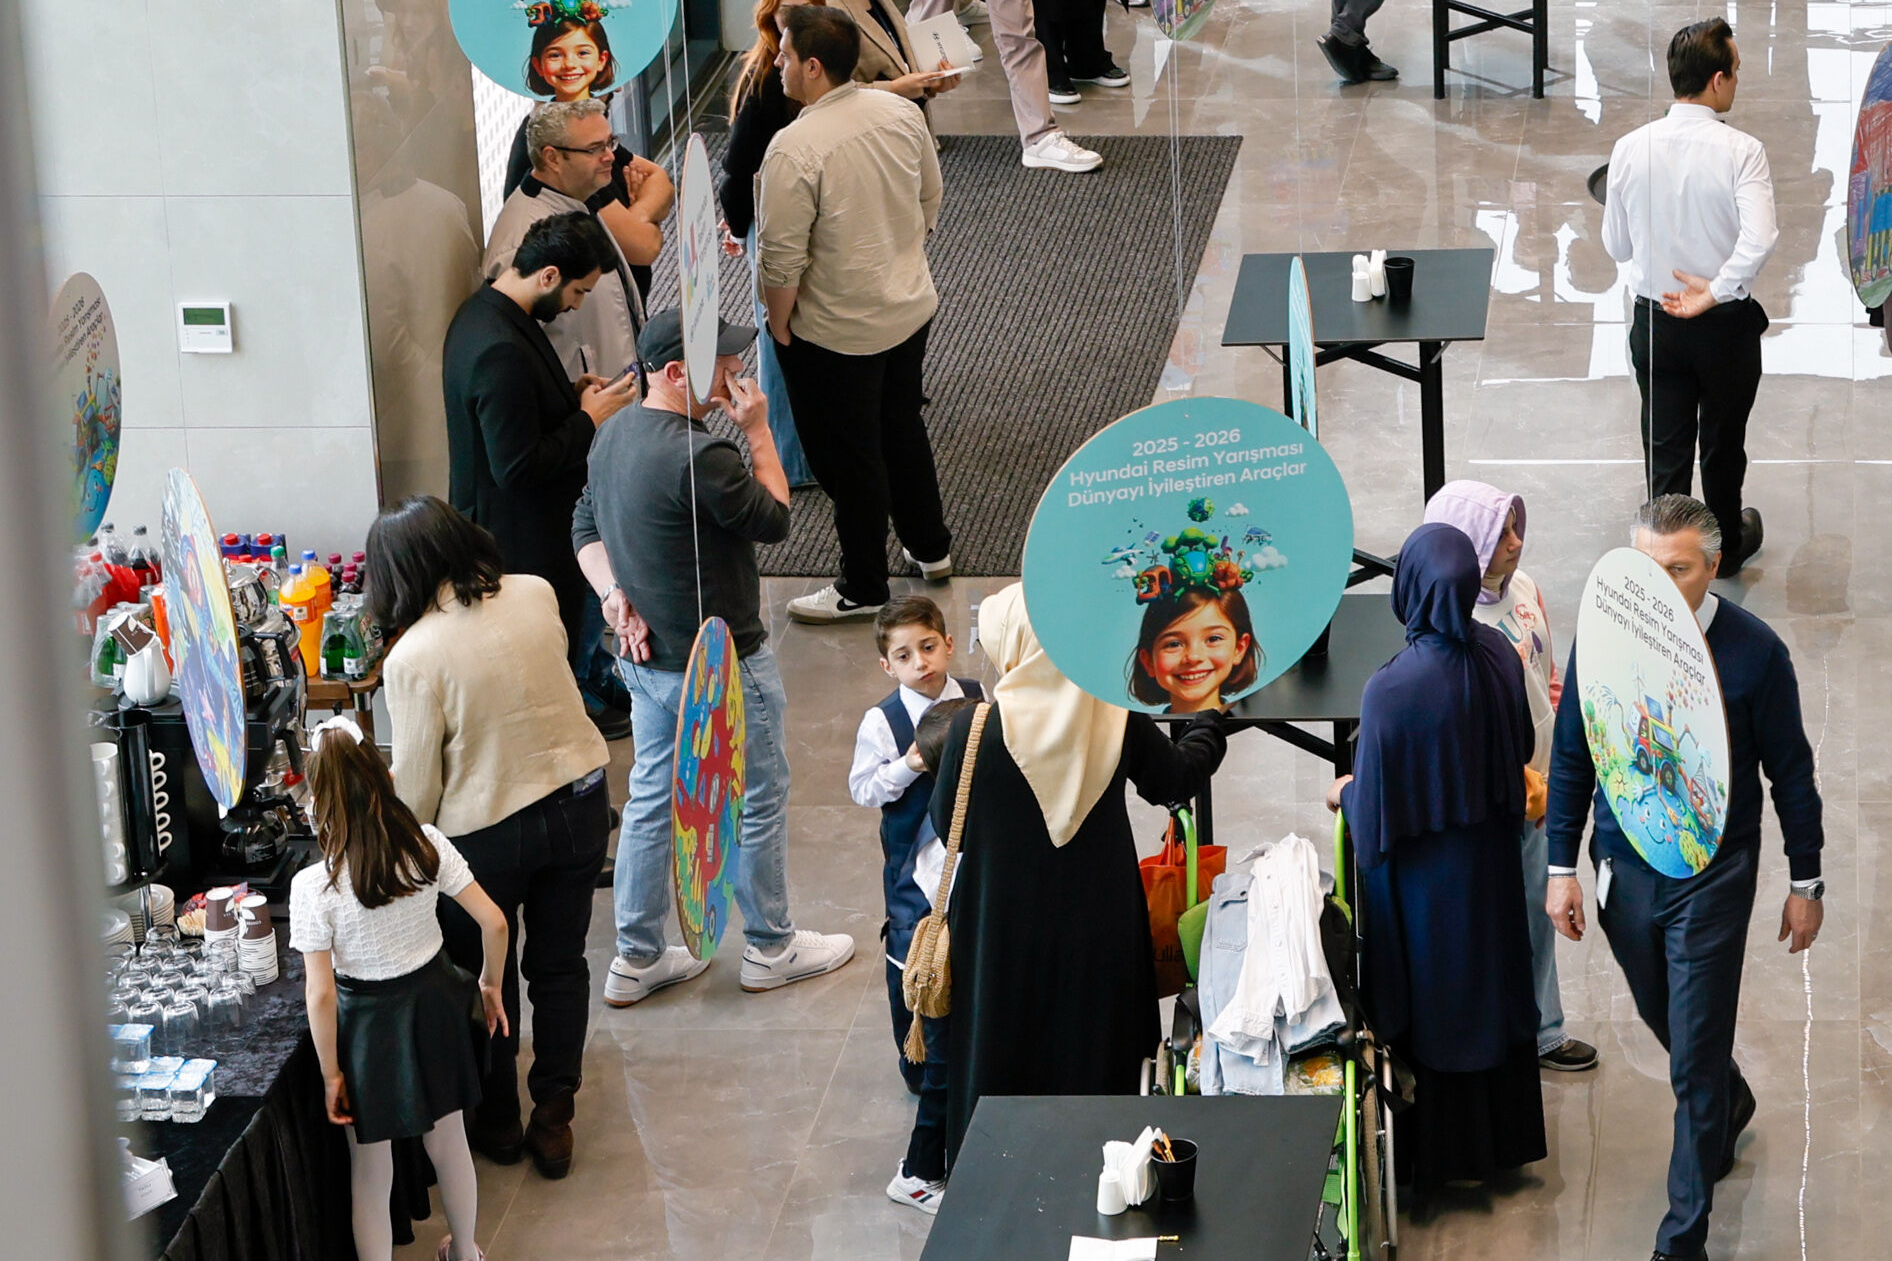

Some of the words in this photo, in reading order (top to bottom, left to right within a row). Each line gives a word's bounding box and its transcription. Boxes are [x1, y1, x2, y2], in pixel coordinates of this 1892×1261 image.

[1070, 461, 1148, 487] Hyundai
[1152, 454, 1209, 474] Resim
[1213, 443, 1303, 463] Yarışması
[1132, 437, 1179, 457] 2025
[1194, 429, 1241, 448] 2026
[1068, 485, 1144, 507] Dünyayı
[1148, 473, 1236, 497] İyileştiren
[1239, 462, 1307, 483] Araçlar
[1597, 576, 1632, 611] Hyundai
[1634, 603, 1660, 631] Resim
[1662, 623, 1704, 664] Yarışması
[1625, 576, 1645, 601] 2025
[1652, 596, 1674, 622] 2026
[1596, 594, 1630, 630] Dünyayı
[1632, 616, 1672, 661] İyileştiren
[1674, 652, 1706, 685] Araçlar
